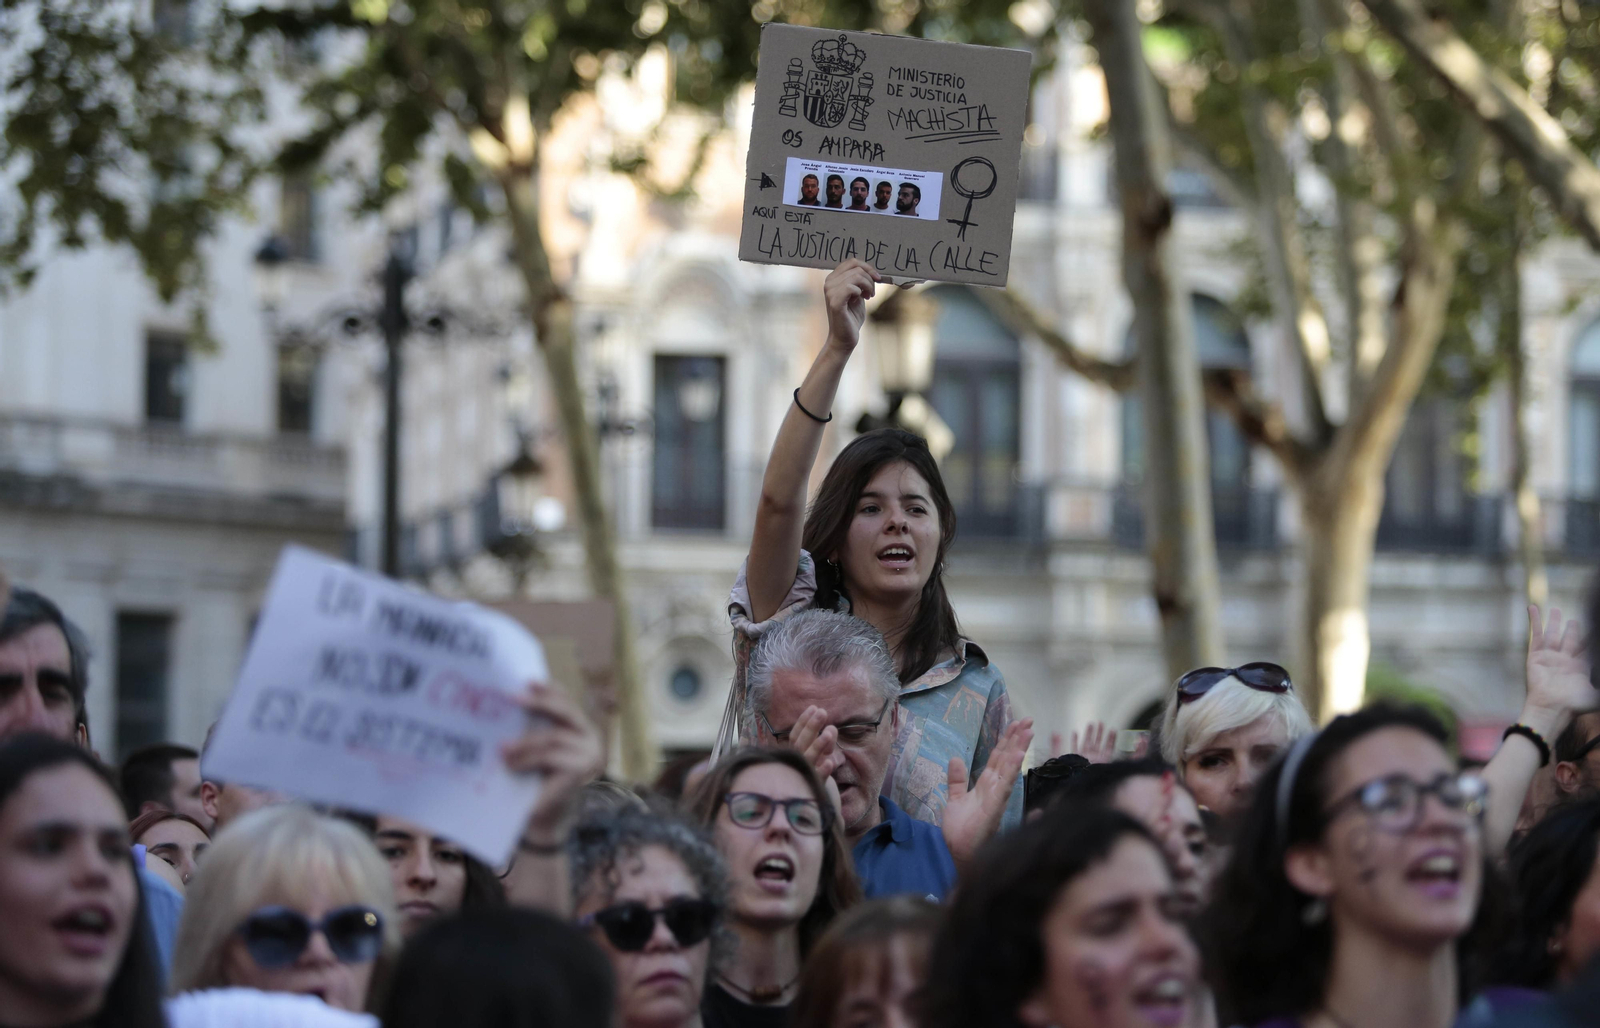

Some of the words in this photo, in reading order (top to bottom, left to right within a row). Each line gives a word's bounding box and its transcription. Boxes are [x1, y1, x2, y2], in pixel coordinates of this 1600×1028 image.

[888, 66, 966, 90] MINISTERIO
[886, 84, 905, 98] DE
[909, 86, 968, 106] JUSTICIA
[887, 103, 998, 132] MACHISTA
[781, 128, 804, 149] OS
[818, 135, 886, 163] AMPARA
[758, 224, 783, 259] LA
[788, 227, 858, 263] JUSTICIA
[865, 239, 888, 270] DE
[894, 243, 921, 273] LA
[929, 240, 998, 276] CALLE
